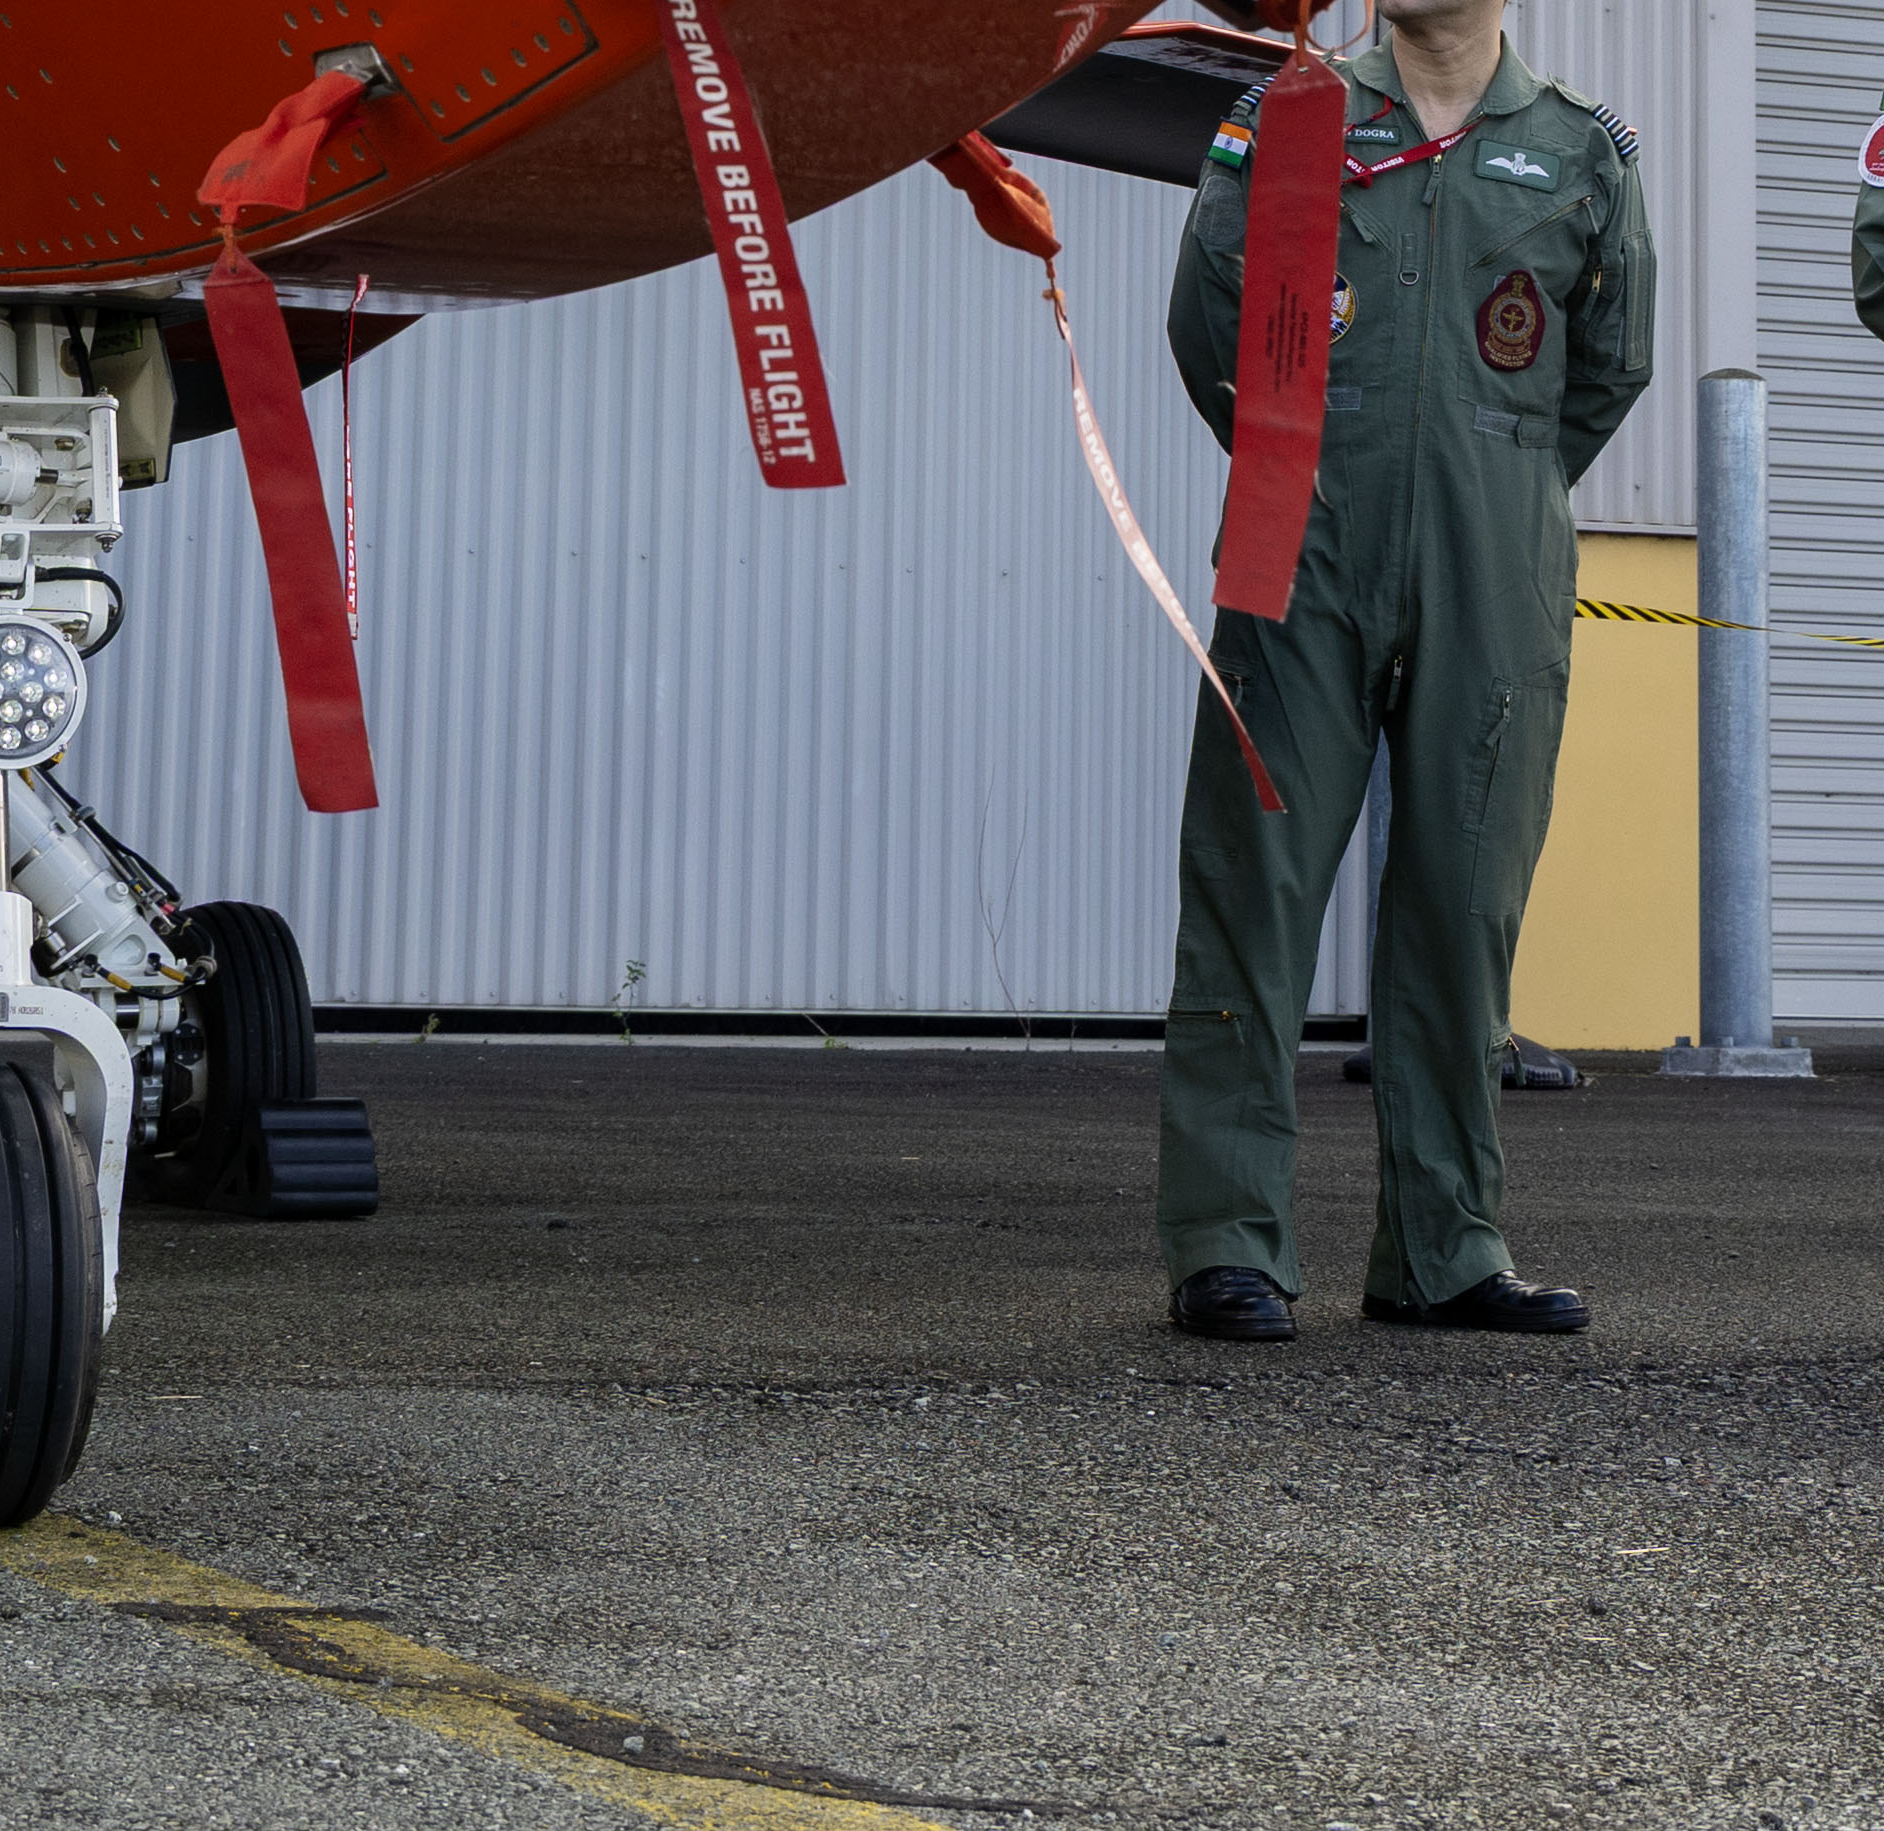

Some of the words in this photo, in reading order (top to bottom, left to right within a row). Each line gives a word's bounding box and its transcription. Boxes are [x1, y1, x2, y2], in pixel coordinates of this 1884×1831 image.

[1354, 129, 1395, 139] DOGRA
[1370, 156, 1405, 172] VISITOR
[717, 163, 785, 312] BEFORE
[755, 325, 817, 464] FLIGHT
[748, 387, 765, 414] NAS
[1073, 386, 1133, 533] REMOVE
